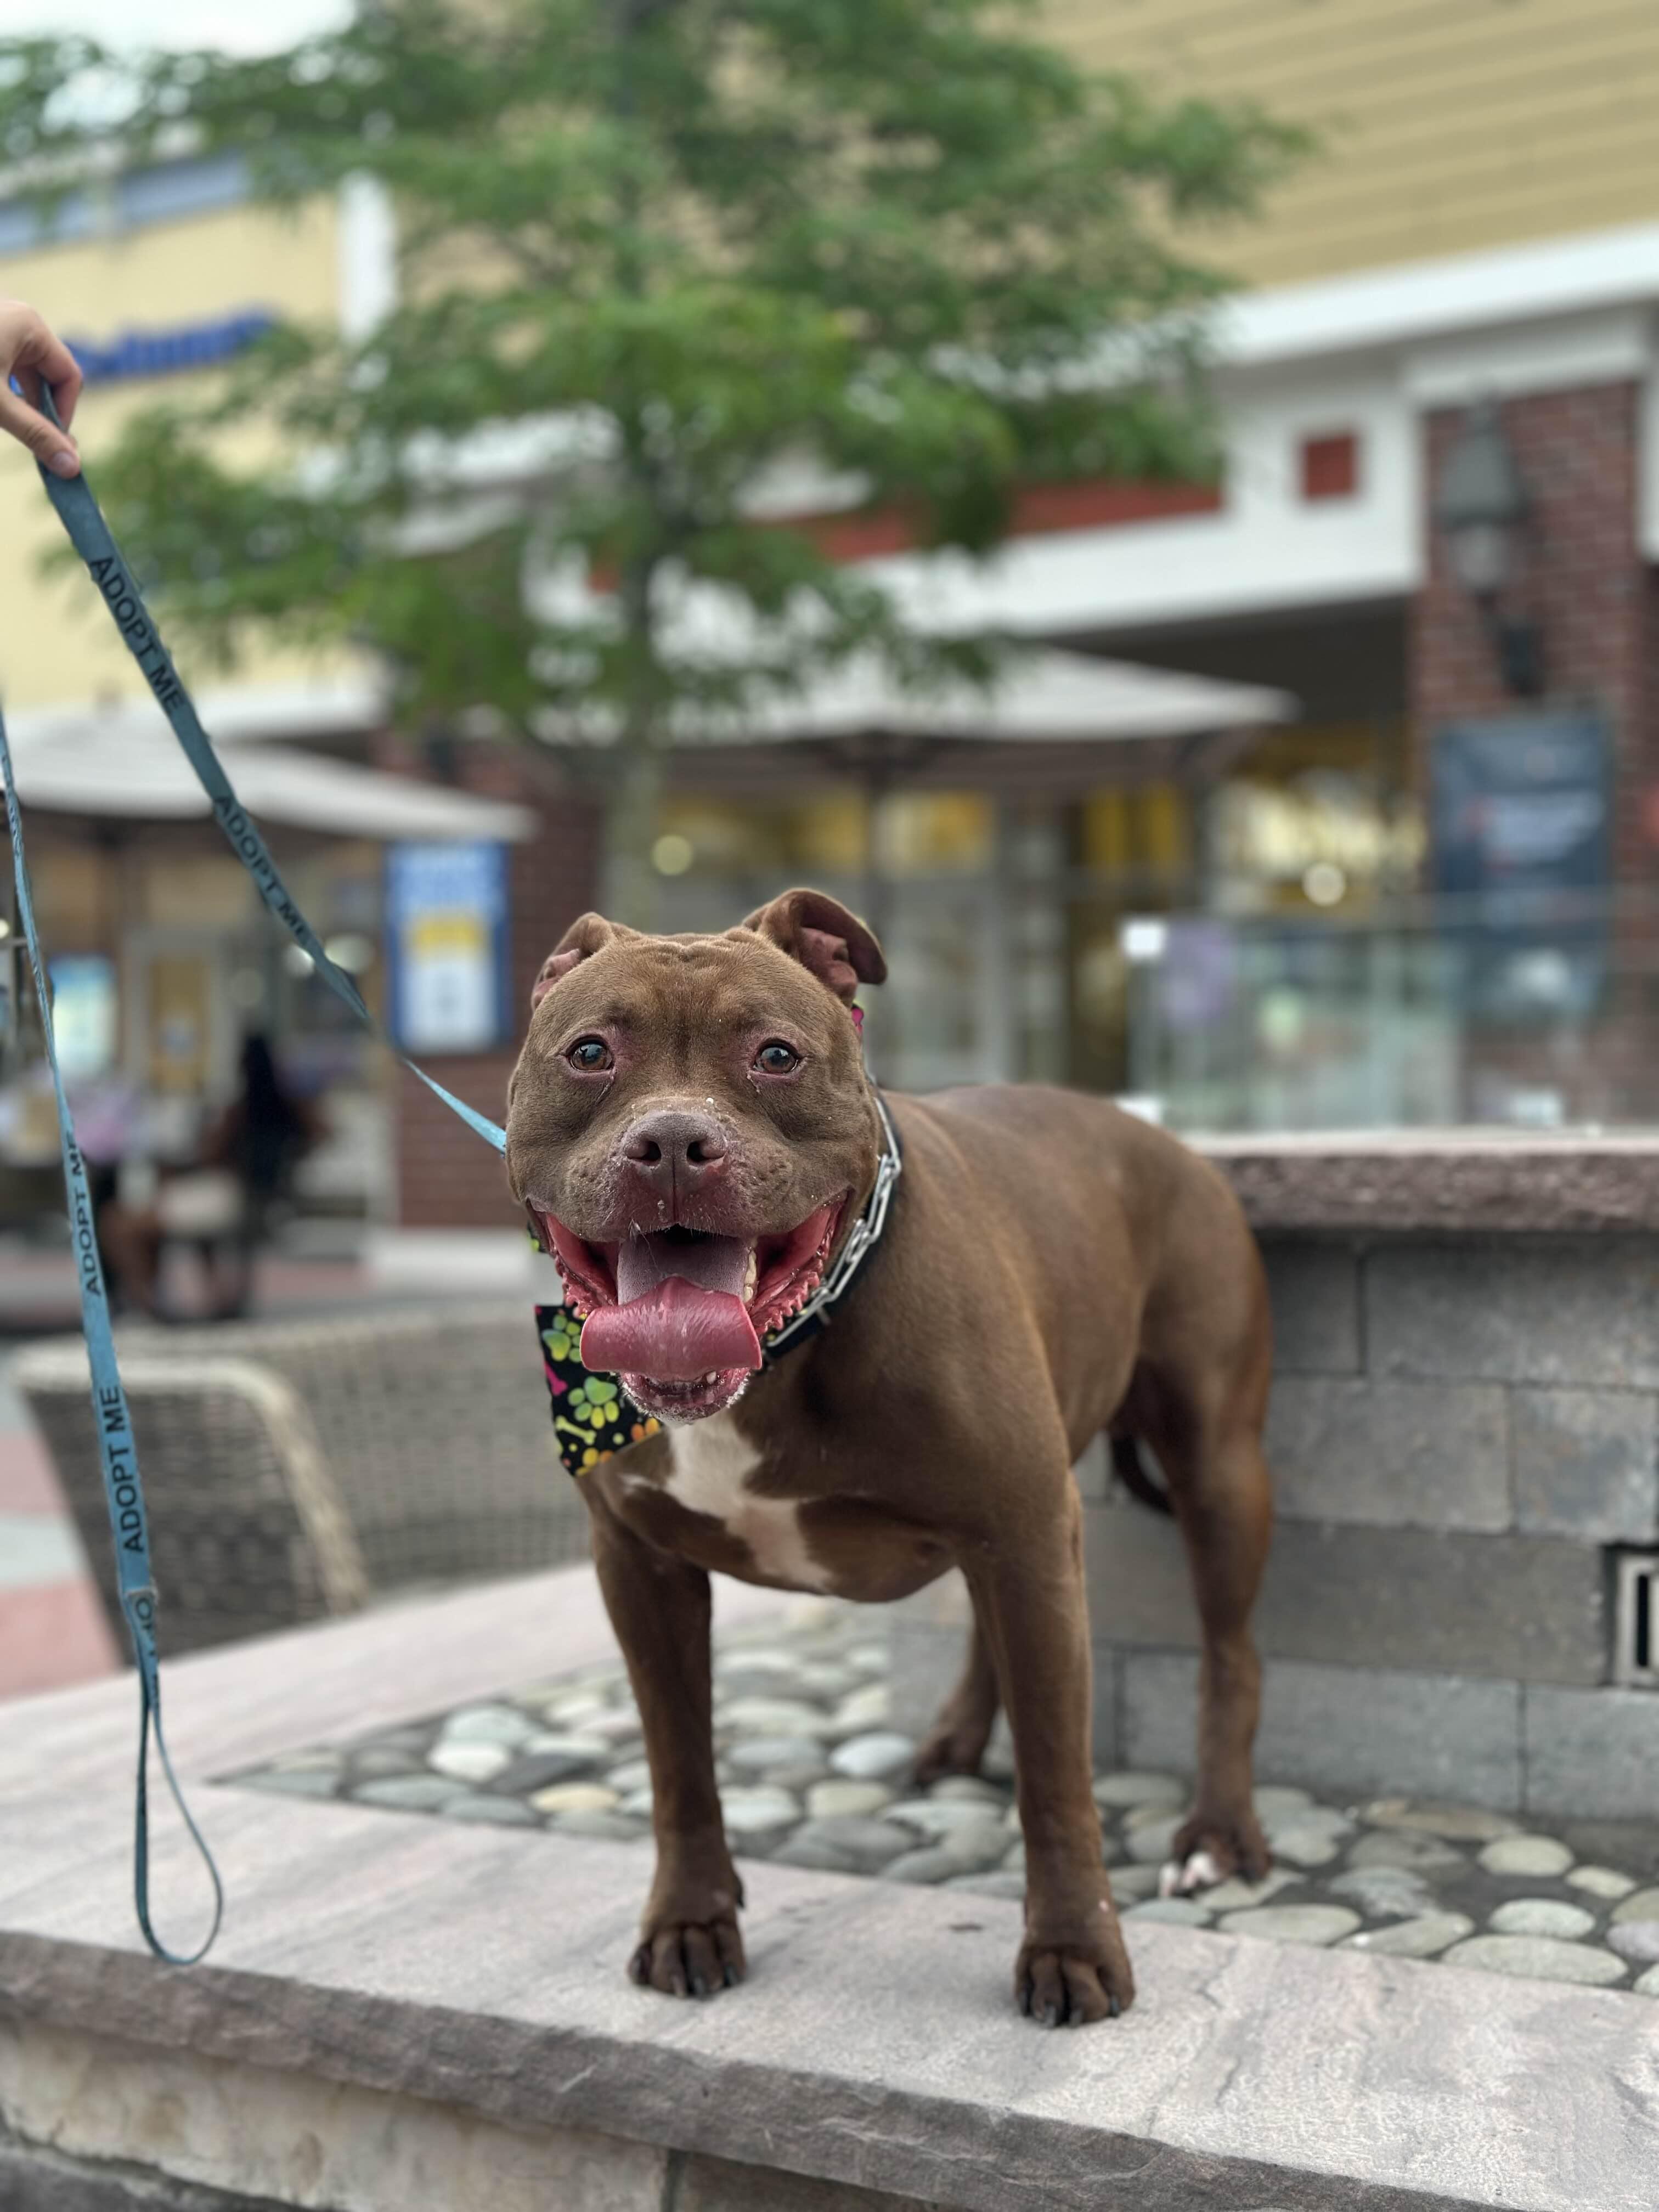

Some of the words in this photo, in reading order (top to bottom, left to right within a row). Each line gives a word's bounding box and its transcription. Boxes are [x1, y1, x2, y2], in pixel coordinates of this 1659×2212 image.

[89, 557, 158, 657] ADOPT
[148, 664, 185, 710] ME
[214, 797, 281, 892] ADOPT
[75, 1186, 101, 1296] ADOPT
[99, 1387, 126, 1434] ME
[108, 1443, 144, 1553] ADOPT
